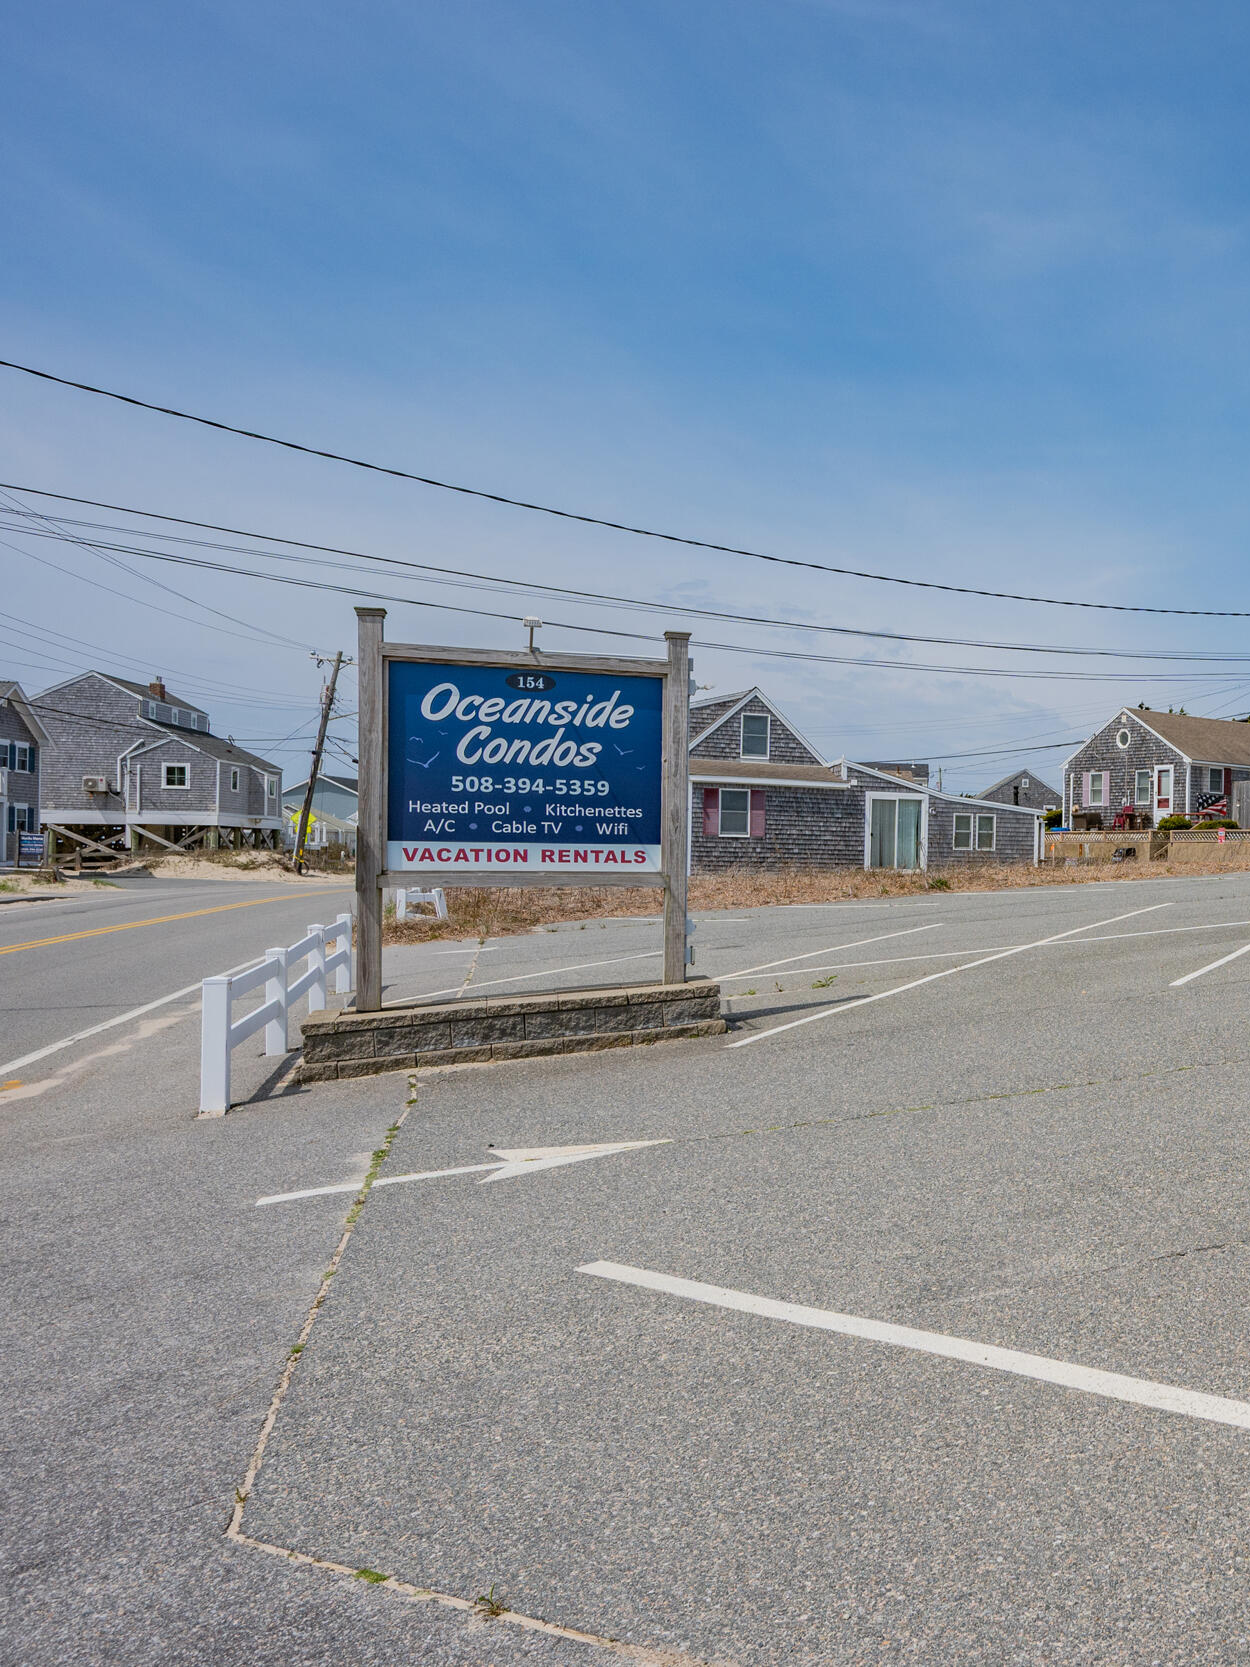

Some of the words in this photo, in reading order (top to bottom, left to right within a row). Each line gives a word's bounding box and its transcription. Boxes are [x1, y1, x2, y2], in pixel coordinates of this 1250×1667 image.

[517, 676, 545, 689] 154
[421, 682, 635, 729] Oceanside
[456, 725, 603, 767] Condos
[451, 776, 610, 796] 508-394-5359
[408, 800, 469, 813] Heated
[474, 802, 510, 815] Pool
[545, 804, 643, 818] Kitchenettes
[423, 818, 456, 834] A/C
[491, 820, 537, 834] Cable
[541, 822, 562, 834] TV
[596, 823, 628, 835] Wifi
[402, 847, 528, 862] VACATION
[541, 849, 647, 864] RENTALS
